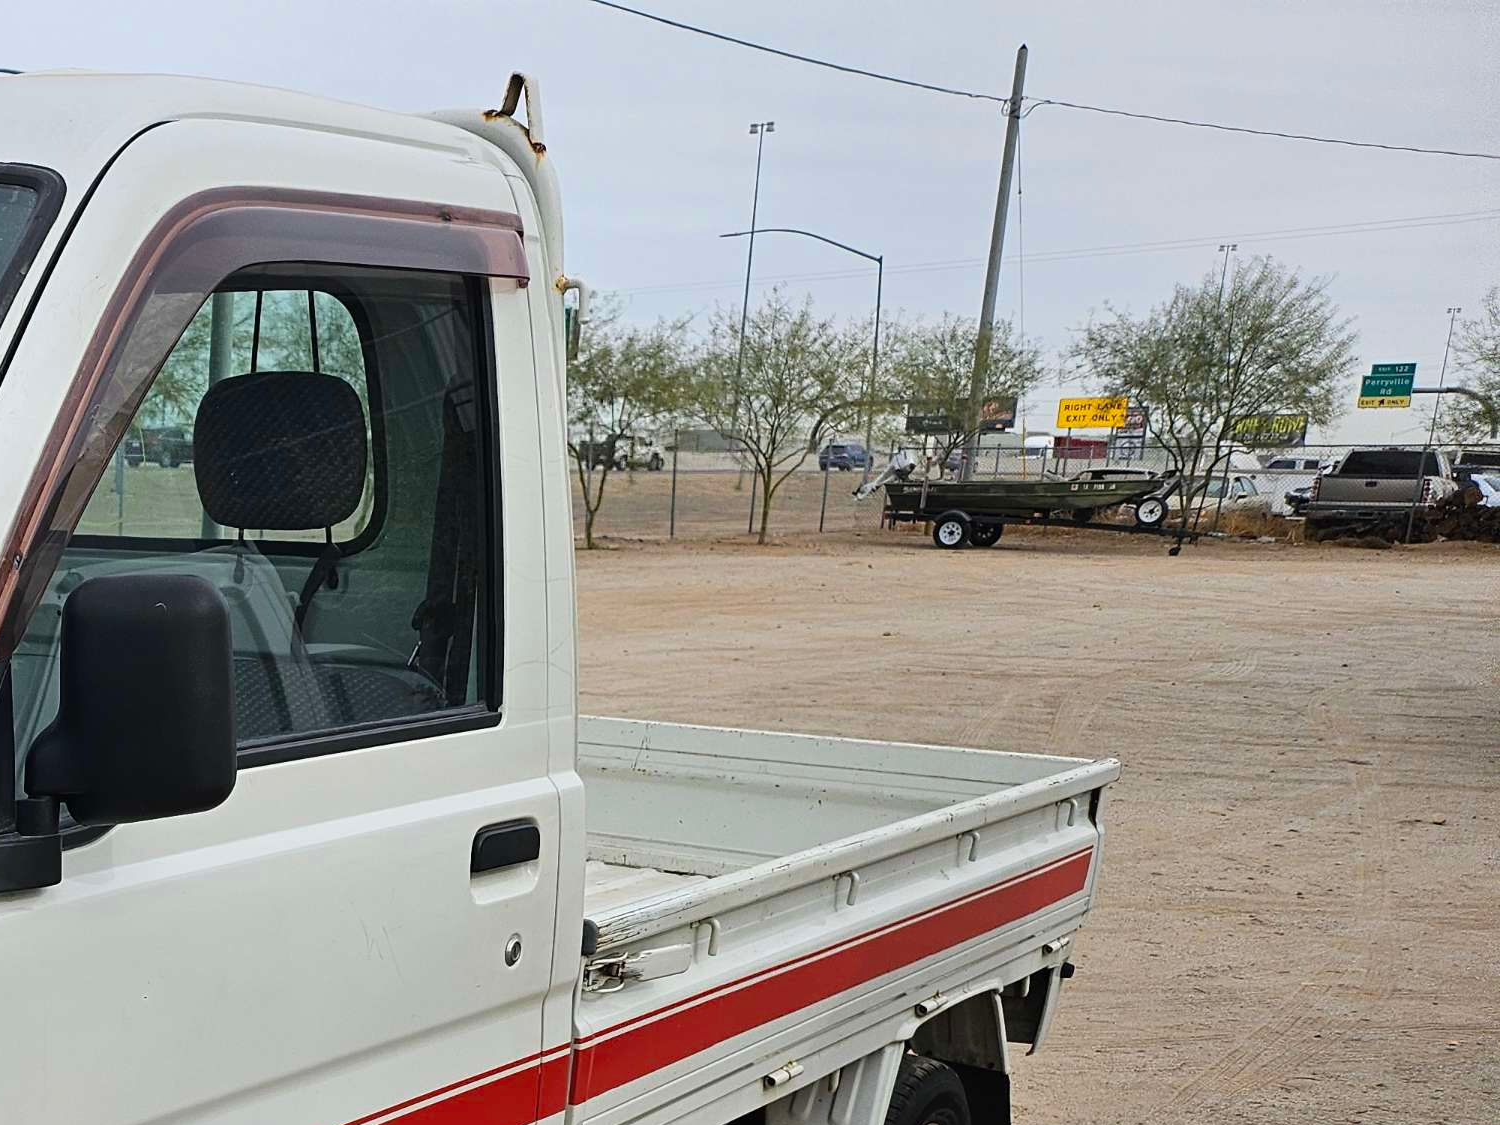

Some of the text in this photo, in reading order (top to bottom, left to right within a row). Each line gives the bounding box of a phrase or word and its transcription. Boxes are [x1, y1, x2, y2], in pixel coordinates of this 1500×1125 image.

[1365, 378, 1410, 386] Perryville
[1064, 403, 1122, 411] RIGHT LANE
[1066, 414, 1118, 422] EXIT ONLY
